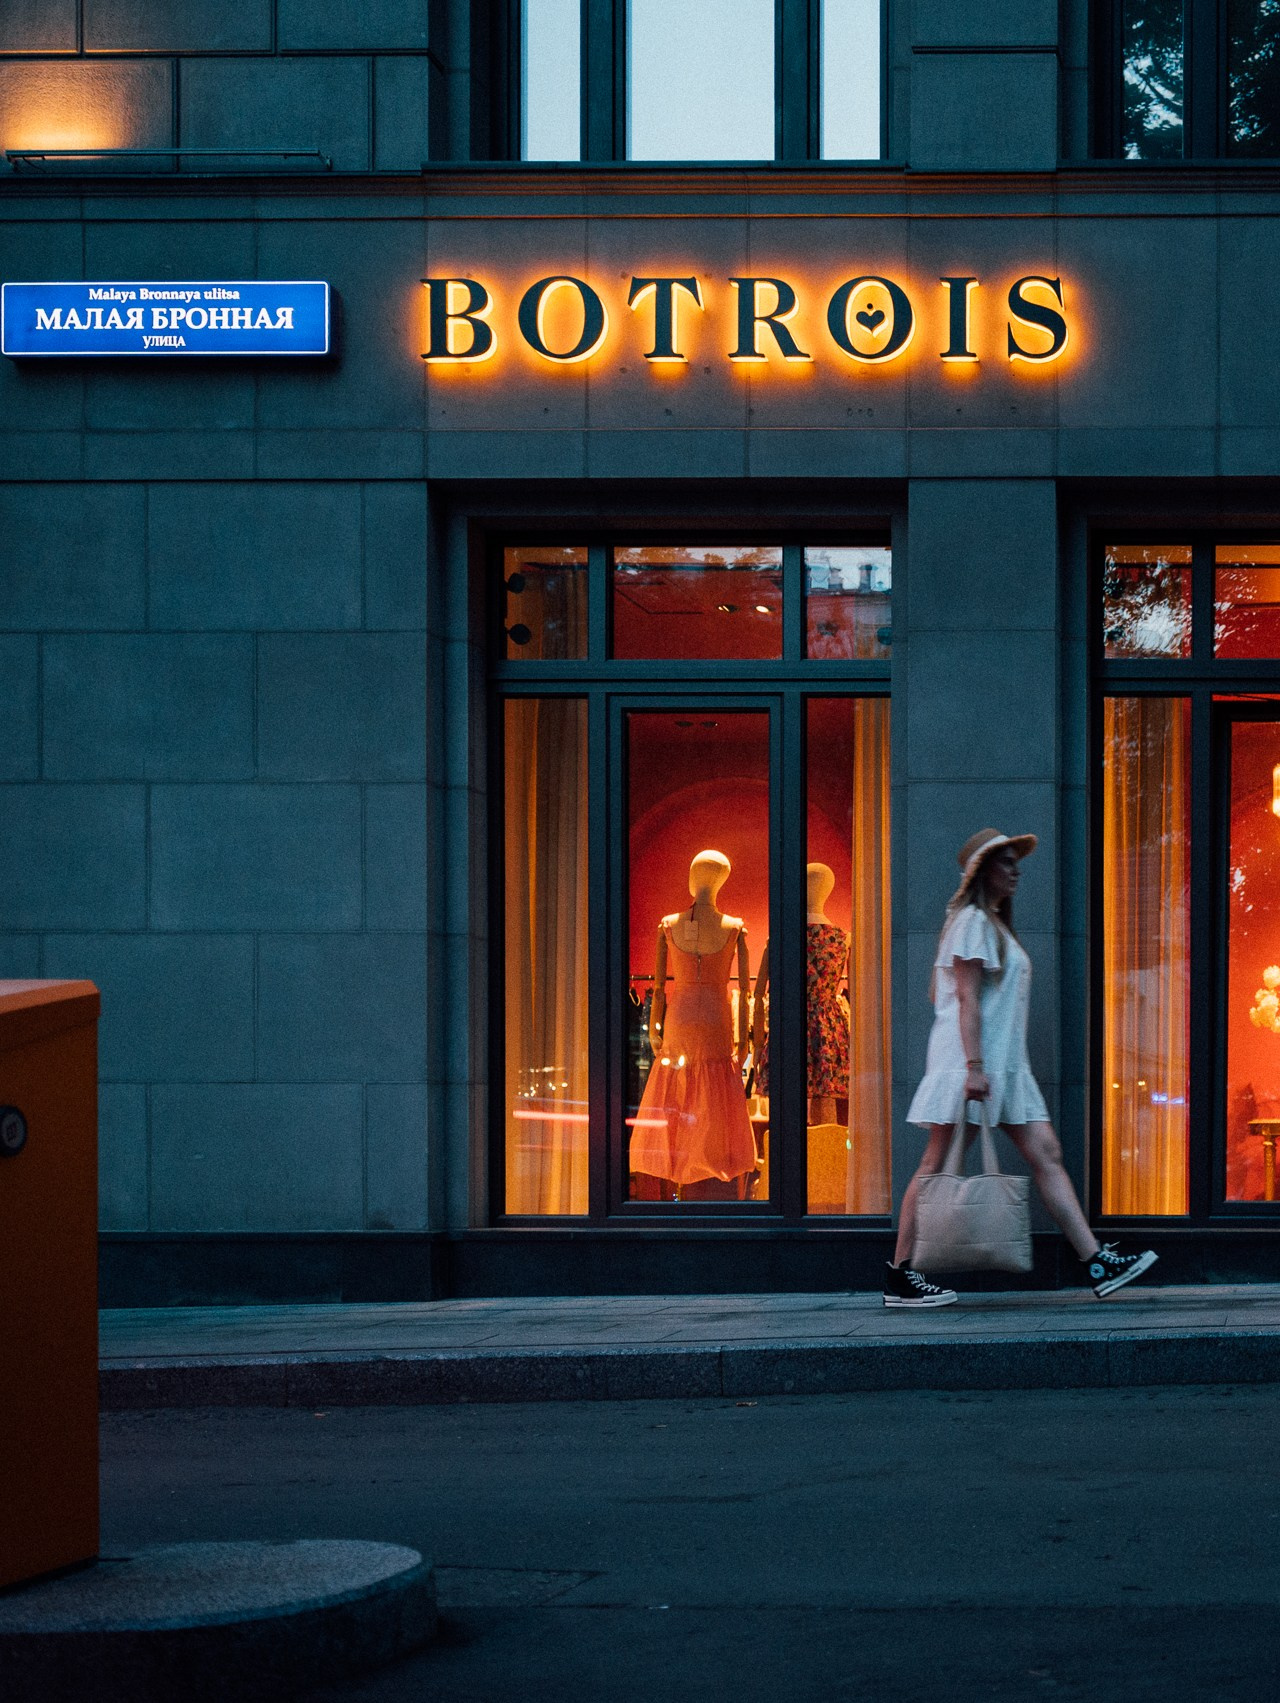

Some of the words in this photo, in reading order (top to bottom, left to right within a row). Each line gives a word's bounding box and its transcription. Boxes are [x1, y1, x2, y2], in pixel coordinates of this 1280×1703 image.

[88, 288, 136, 303] Malaya
[139, 288, 201, 303] Bronnaya
[204, 288, 240, 300] ulitsa
[35, 307, 145, 330] МАЛАЯ
[151, 307, 294, 330] БРОННАЯ
[420, 275, 1069, 363] BOTROIS
